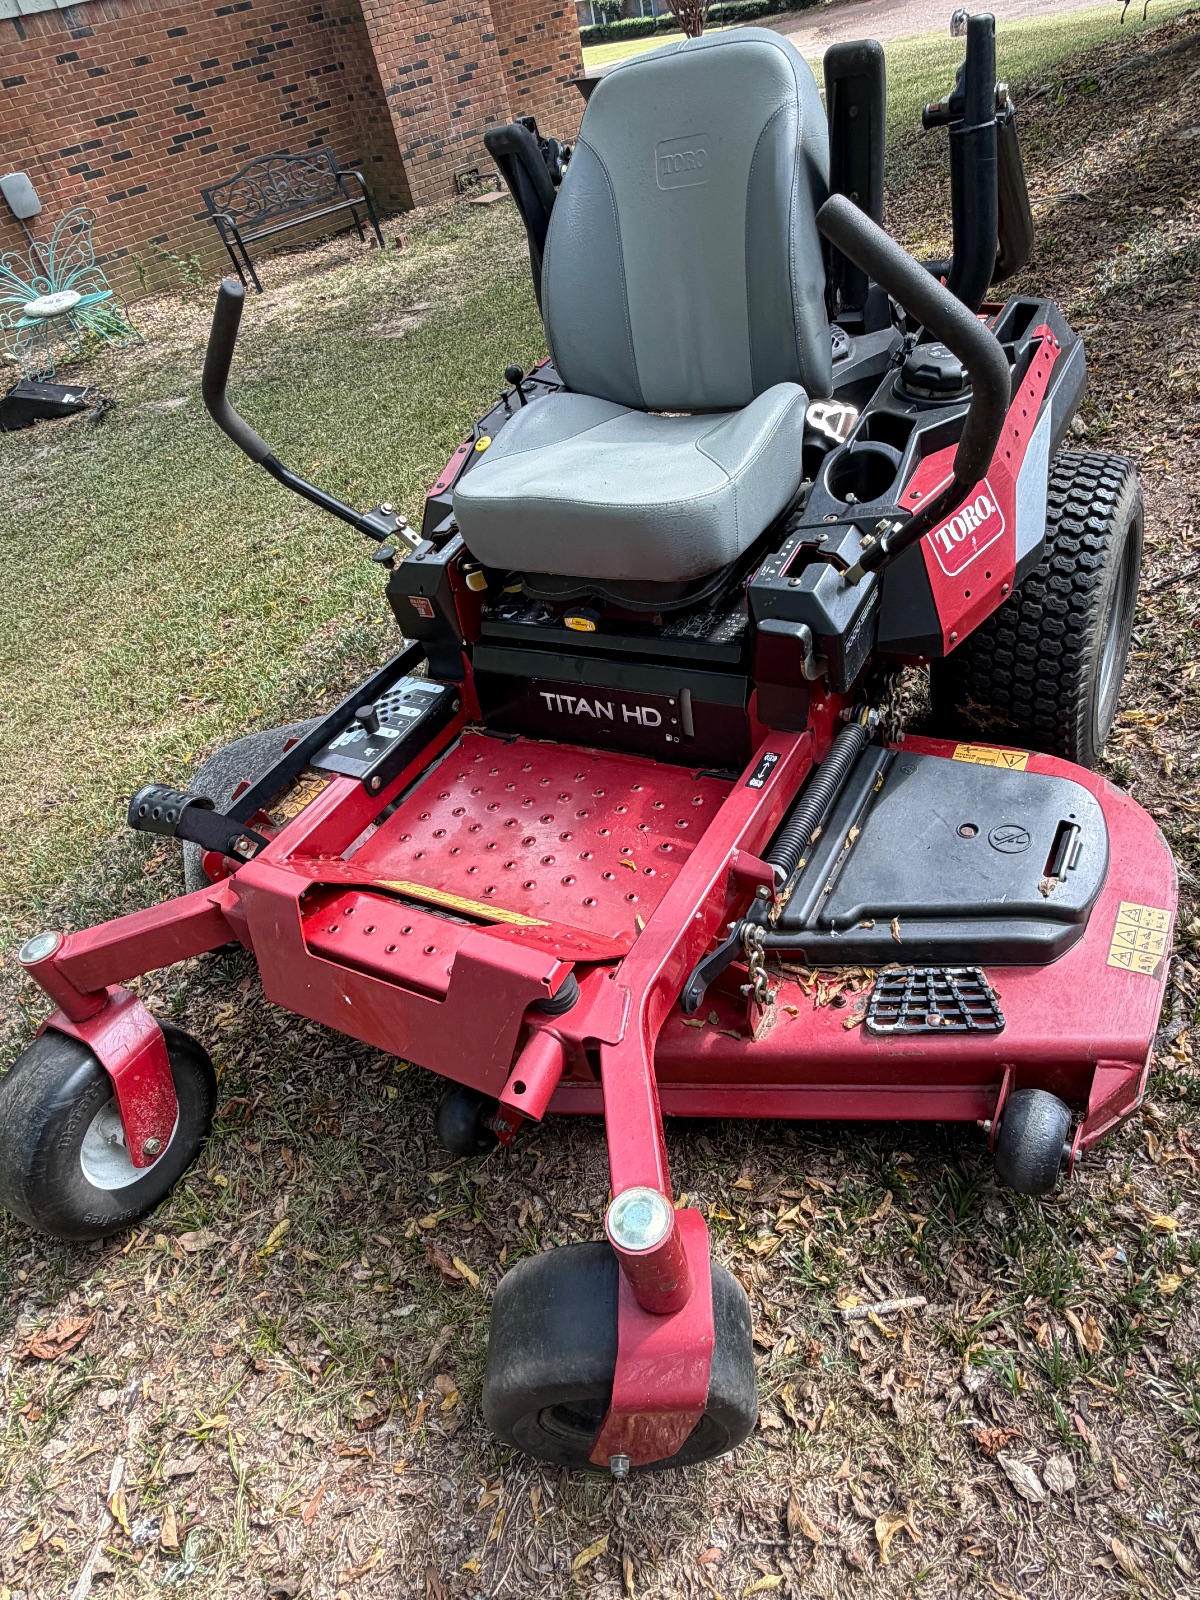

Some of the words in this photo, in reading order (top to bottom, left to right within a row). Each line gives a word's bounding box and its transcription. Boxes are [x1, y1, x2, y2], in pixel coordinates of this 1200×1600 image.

[660, 148, 708, 175] TORO
[934, 495, 992, 554] TORO
[539, 691, 614, 721] TITAN
[621, 703, 662, 727] HD
